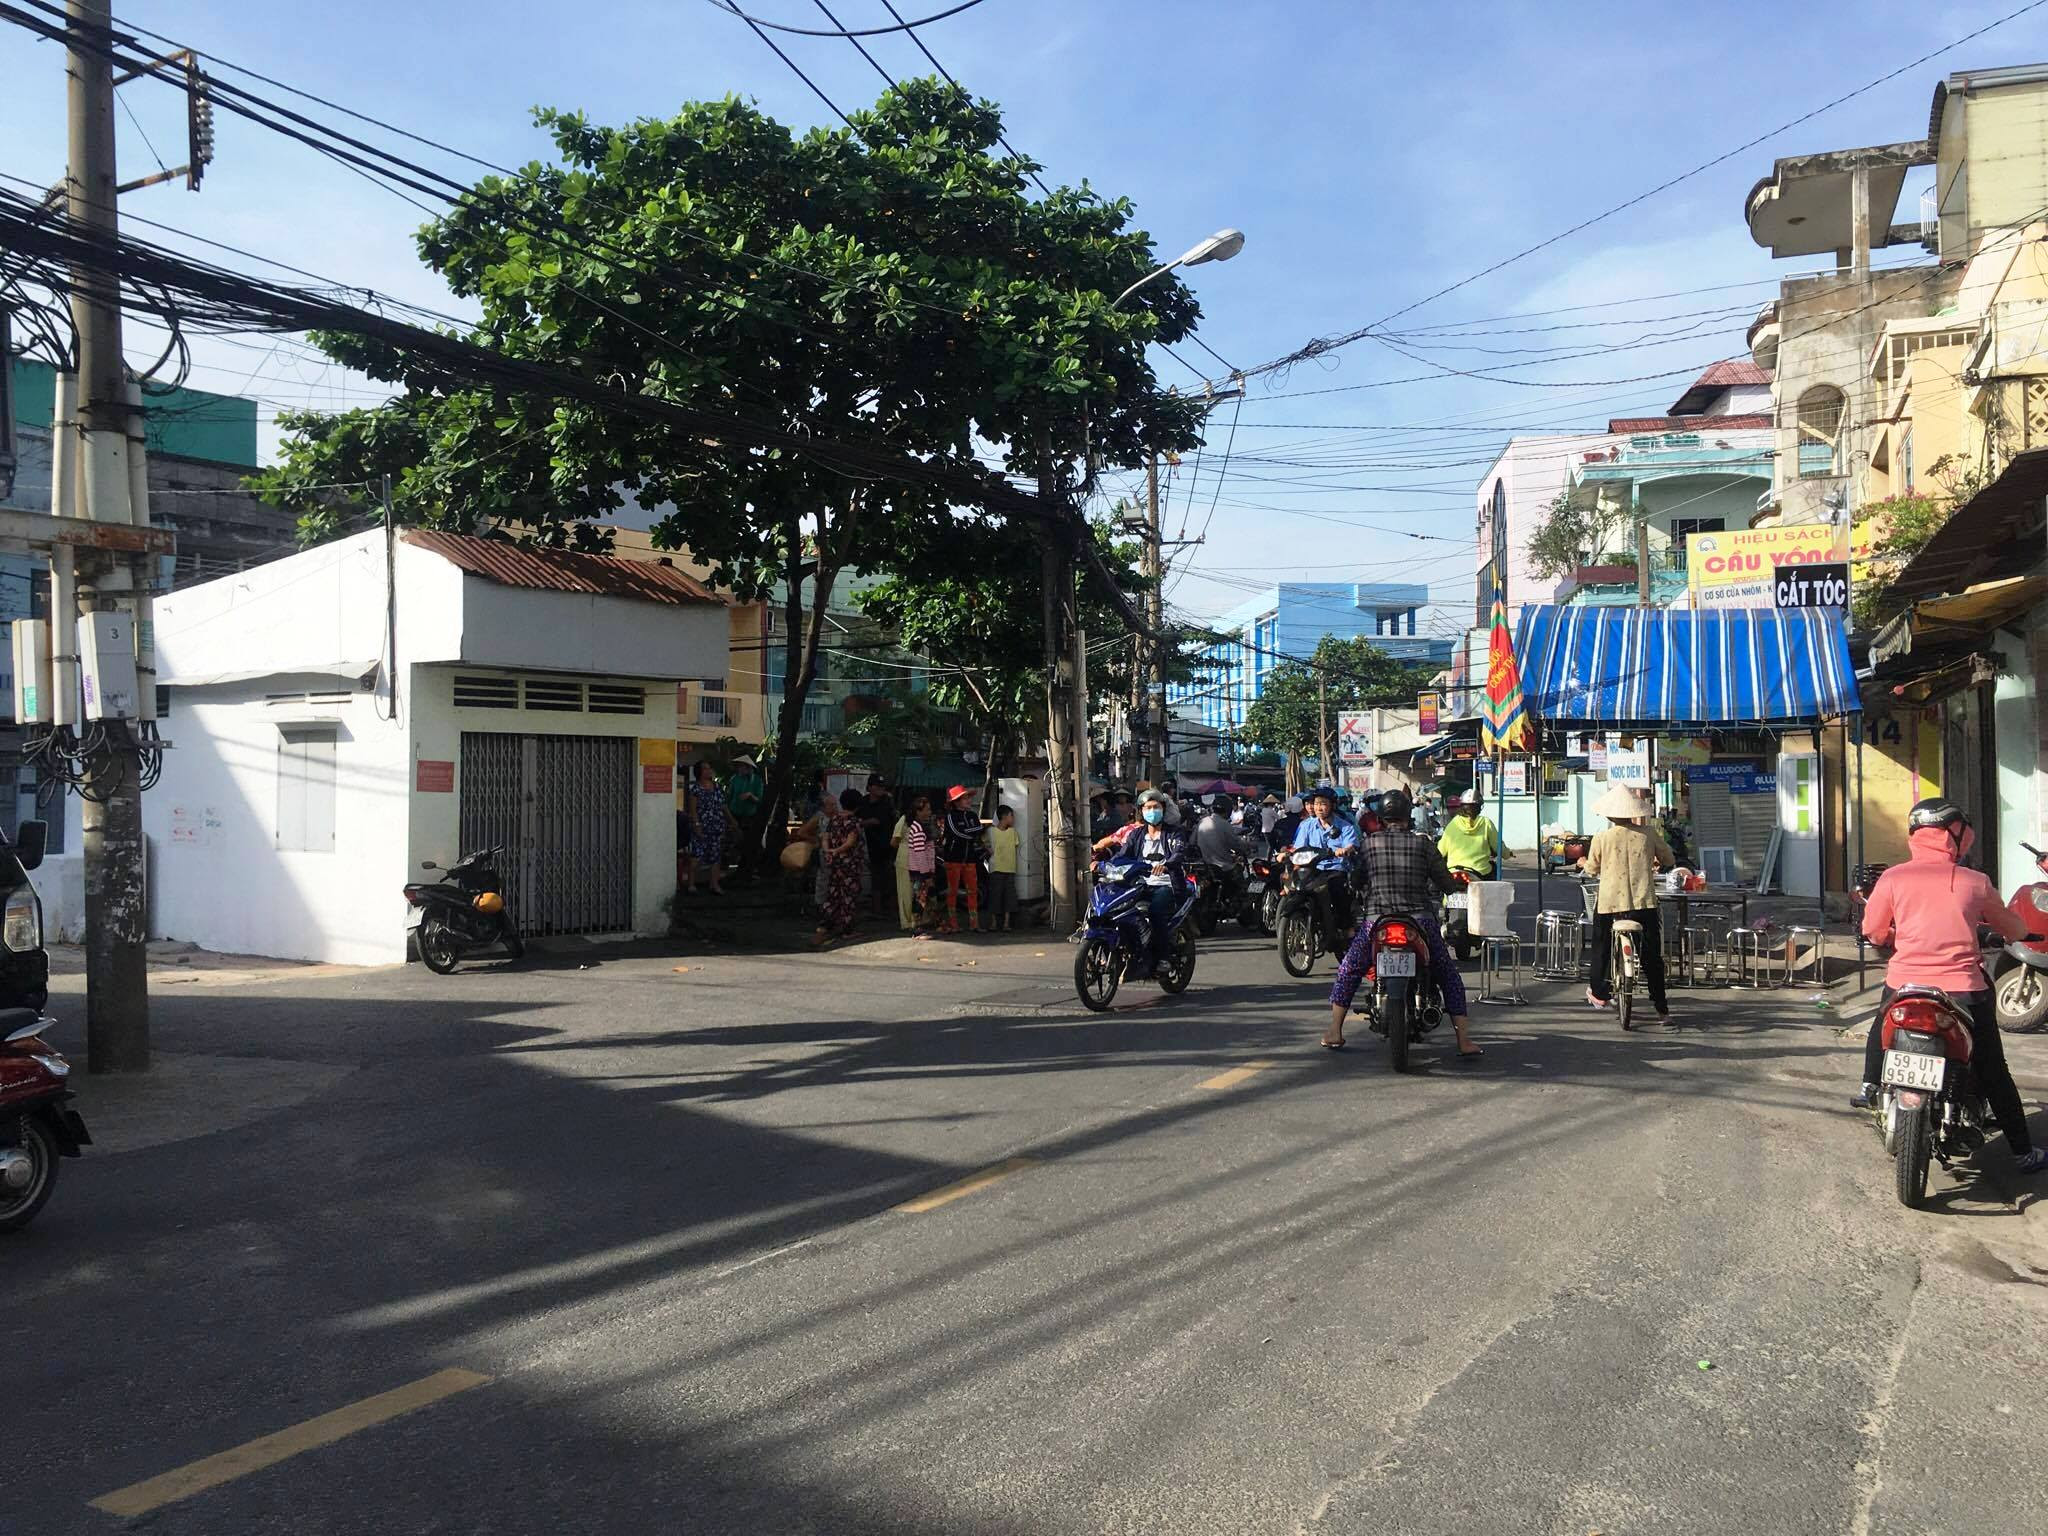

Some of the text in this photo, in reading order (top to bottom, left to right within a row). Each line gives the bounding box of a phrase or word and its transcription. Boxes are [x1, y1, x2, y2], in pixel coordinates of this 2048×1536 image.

[1705, 549, 1761, 573] CẦU
[1776, 570, 1846, 607] CẮT TÓC
[110, 628, 120, 640] 3
[1866, 719, 1902, 745] 14
[1383, 965, 1409, 975] 1047
[1887, 1068, 1938, 1088] 958.44
